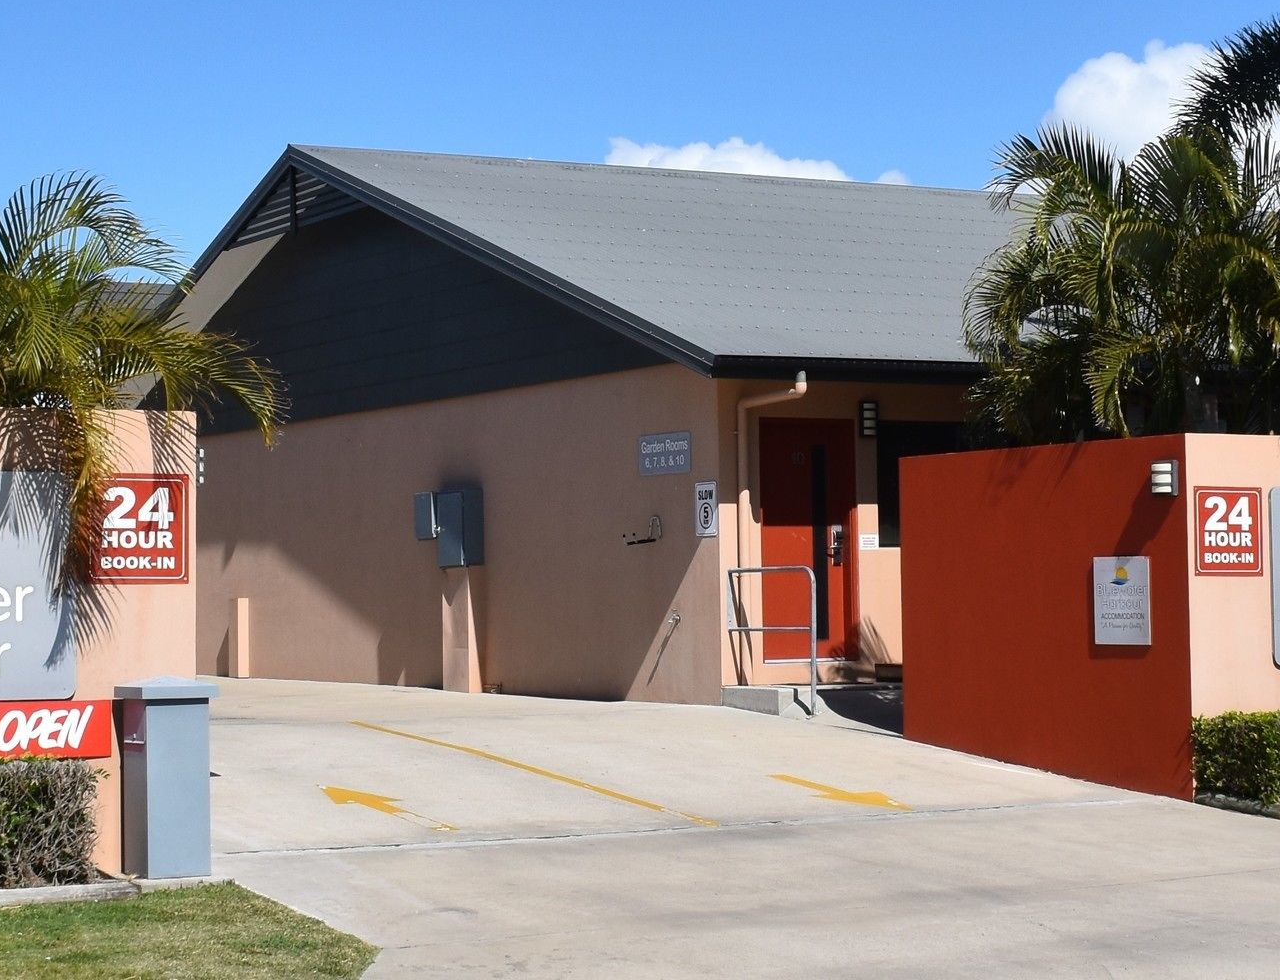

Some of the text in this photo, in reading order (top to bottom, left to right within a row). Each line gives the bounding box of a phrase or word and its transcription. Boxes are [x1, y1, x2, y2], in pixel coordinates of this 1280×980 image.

[641, 439, 688, 454] Garden Rooms
[645, 457, 652, 468] 6,
[653, 457, 659, 467] 7,
[669, 456, 674, 466] &
[676, 454, 684, 465] 10
[698, 490, 713, 500] SLOW
[103, 486, 174, 529] 24
[703, 506, 709, 519] 5
[1204, 496, 1253, 531] 24
[101, 530, 174, 549] HOUR
[1204, 532, 1252, 548] HOUR
[101, 556, 175, 569] BOOK-IN
[1204, 552, 1254, 564] BOOK-IN
